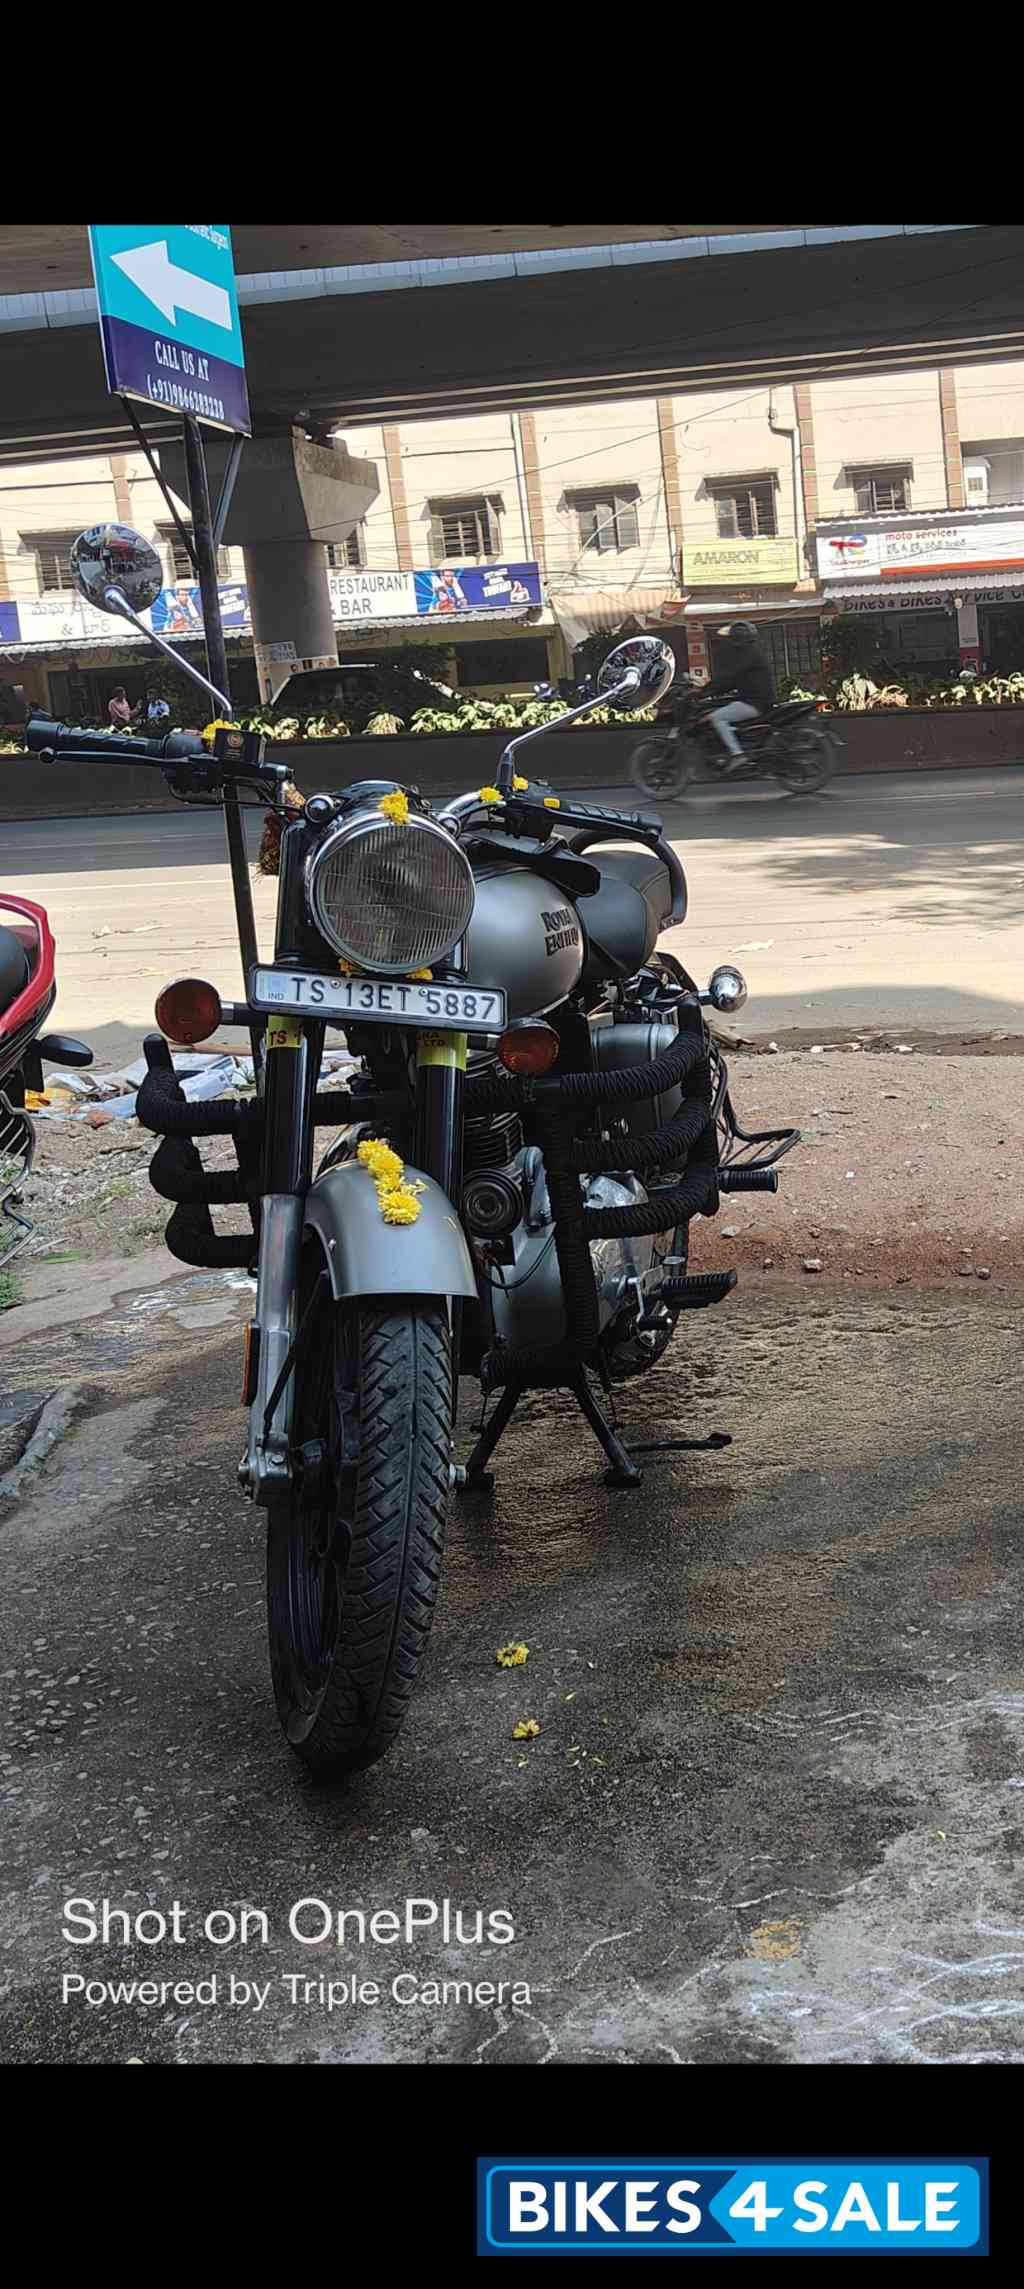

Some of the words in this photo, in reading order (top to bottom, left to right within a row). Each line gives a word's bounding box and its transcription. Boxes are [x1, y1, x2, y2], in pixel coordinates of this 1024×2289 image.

[155, 340, 180, 370] CALL
[181, 350, 195, 376] US
[198, 357, 209, 381] AT
[885, 532, 912, 541] moto
[916, 528, 958, 539] services
[693, 550, 759, 565] AMARON
[330, 574, 408, 595] RESTAURANT
[340, 598, 372, 615] BAR
[267, 993, 285, 1001] IND
[291, 977, 325, 1003] TS
[346, 983, 411, 1011] 13ET
[425, 993, 496, 1020] 5887
